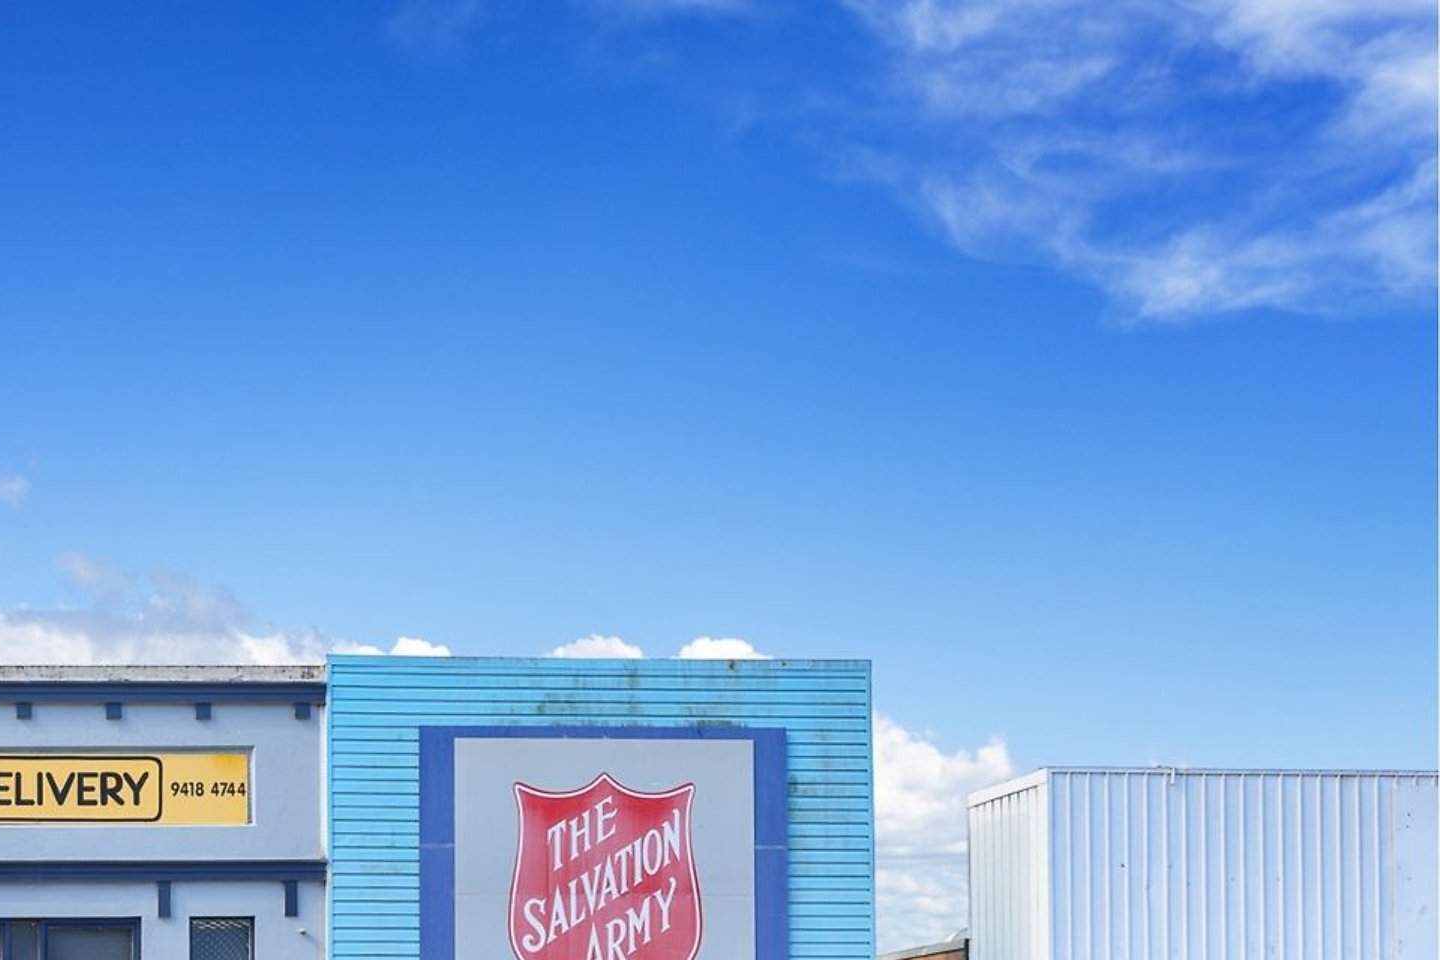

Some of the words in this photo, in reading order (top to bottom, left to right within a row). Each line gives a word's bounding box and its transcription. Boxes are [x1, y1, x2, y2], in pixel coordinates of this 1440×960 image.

[170, 781, 205, 798] 9418
[210, 782, 246, 796] 4744
[547, 796, 618, 871] THE
[522, 808, 681, 952] SALVATION
